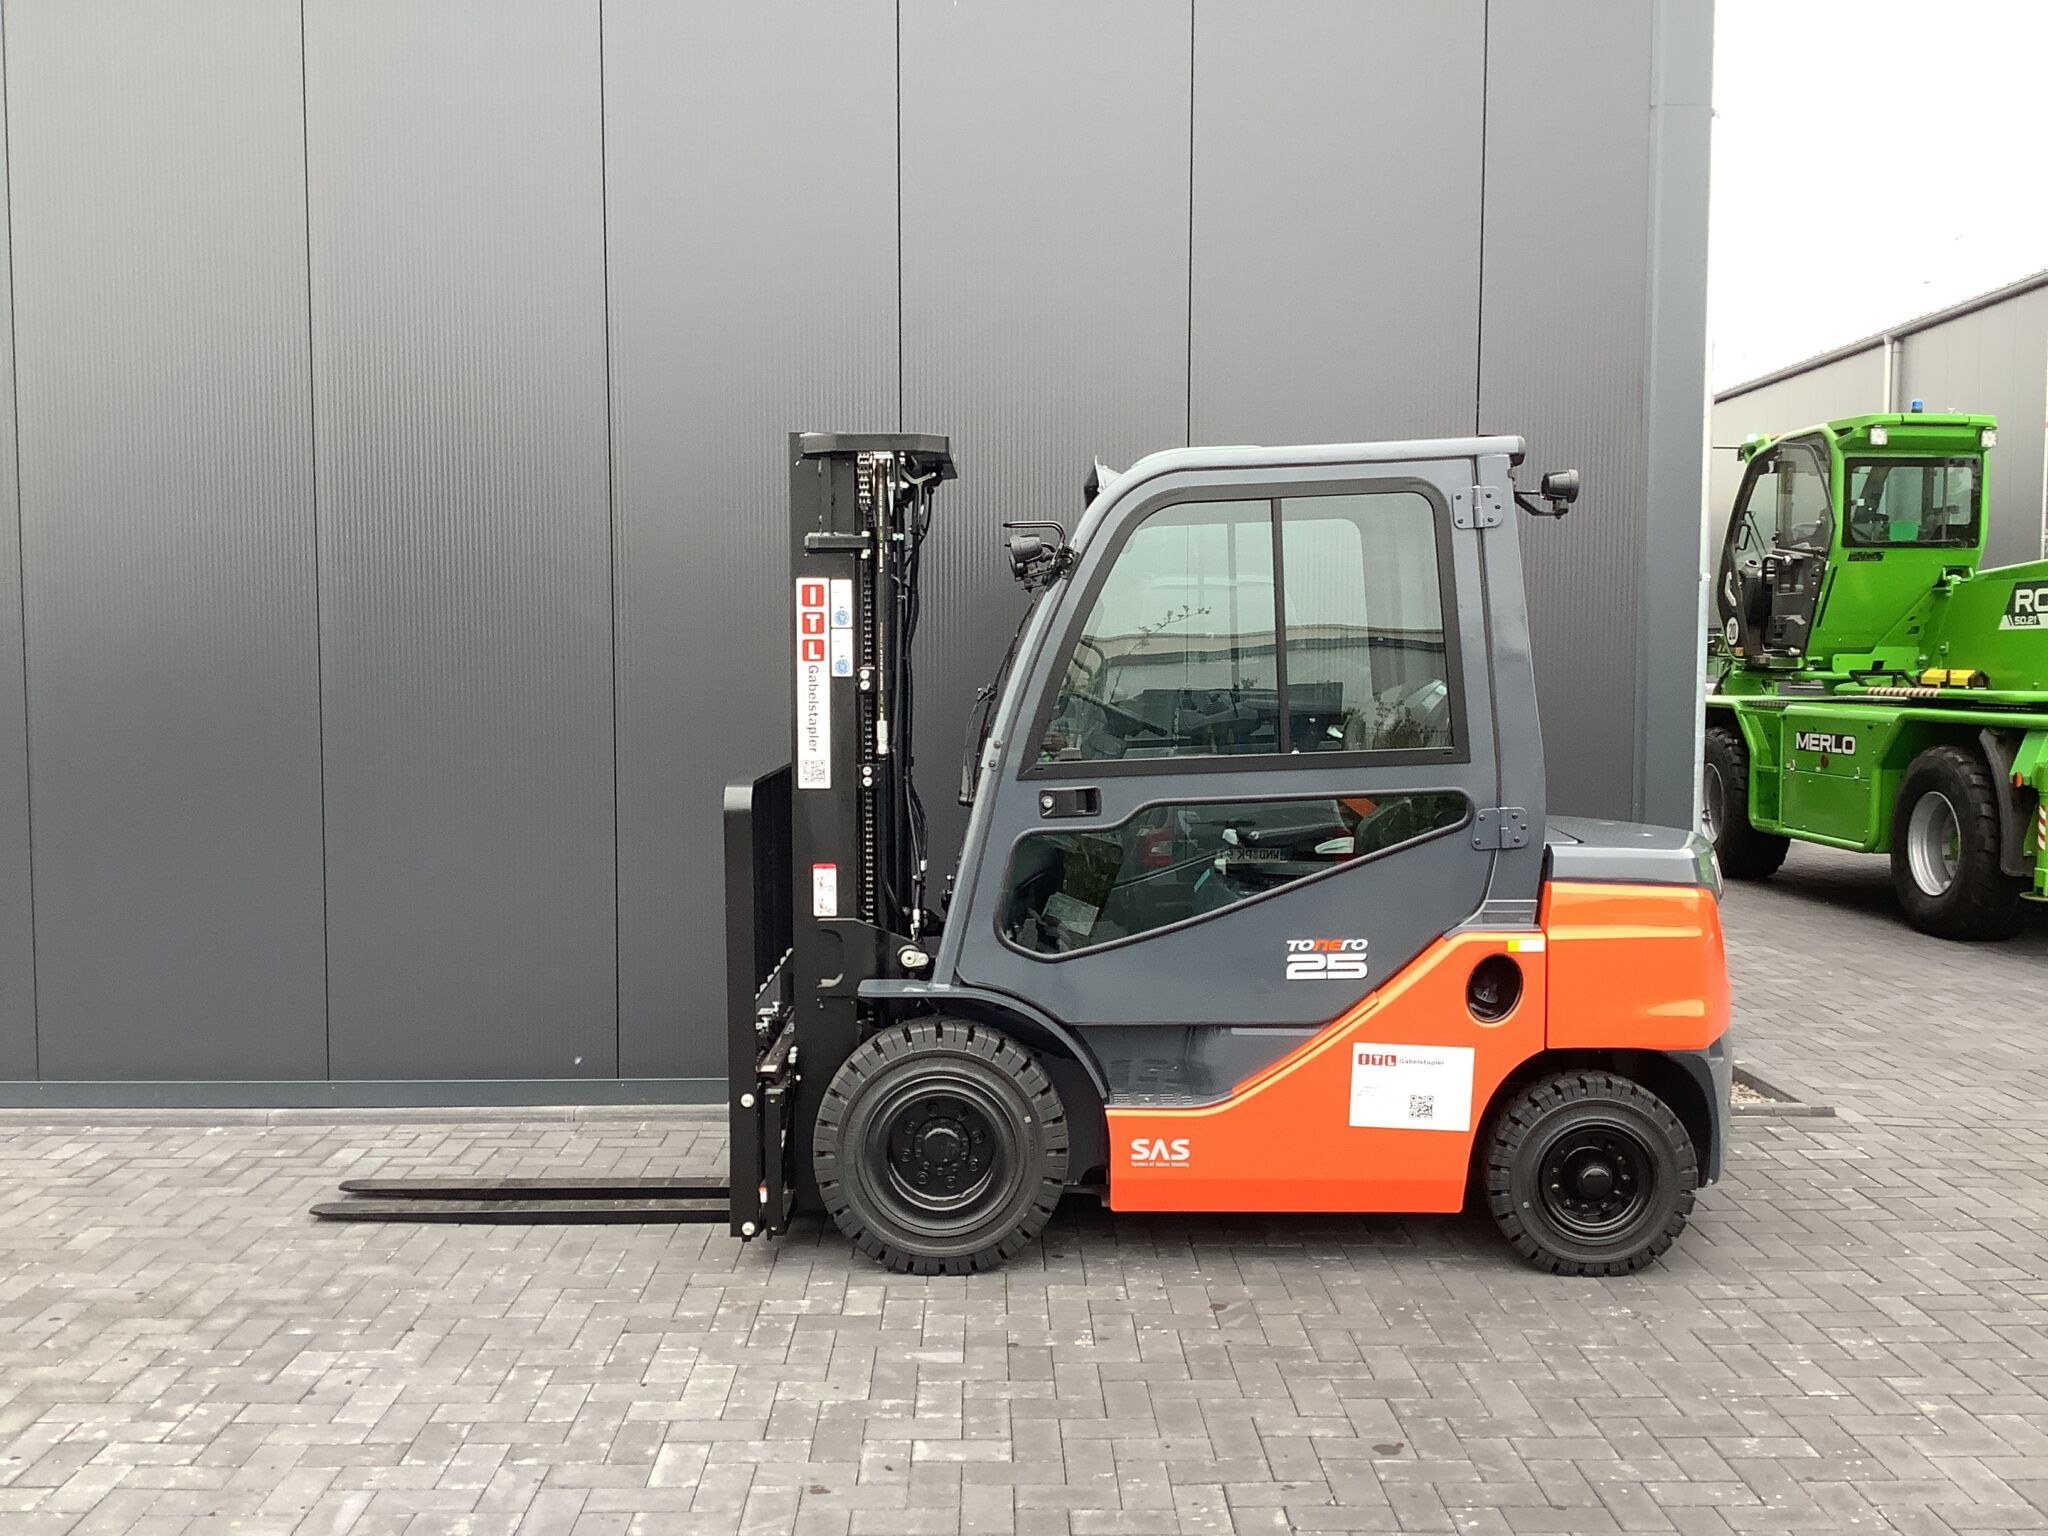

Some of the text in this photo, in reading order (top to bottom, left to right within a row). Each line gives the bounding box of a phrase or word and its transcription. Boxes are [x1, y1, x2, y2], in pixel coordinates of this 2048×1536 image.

[802, 584, 825, 752] ITL Gabelstapler
[1796, 731, 1856, 755] MERLO
[1286, 953, 1368, 980] 25
[1358, 1053, 1397, 1066] ITL
[1131, 1138, 1190, 1161] SAS
